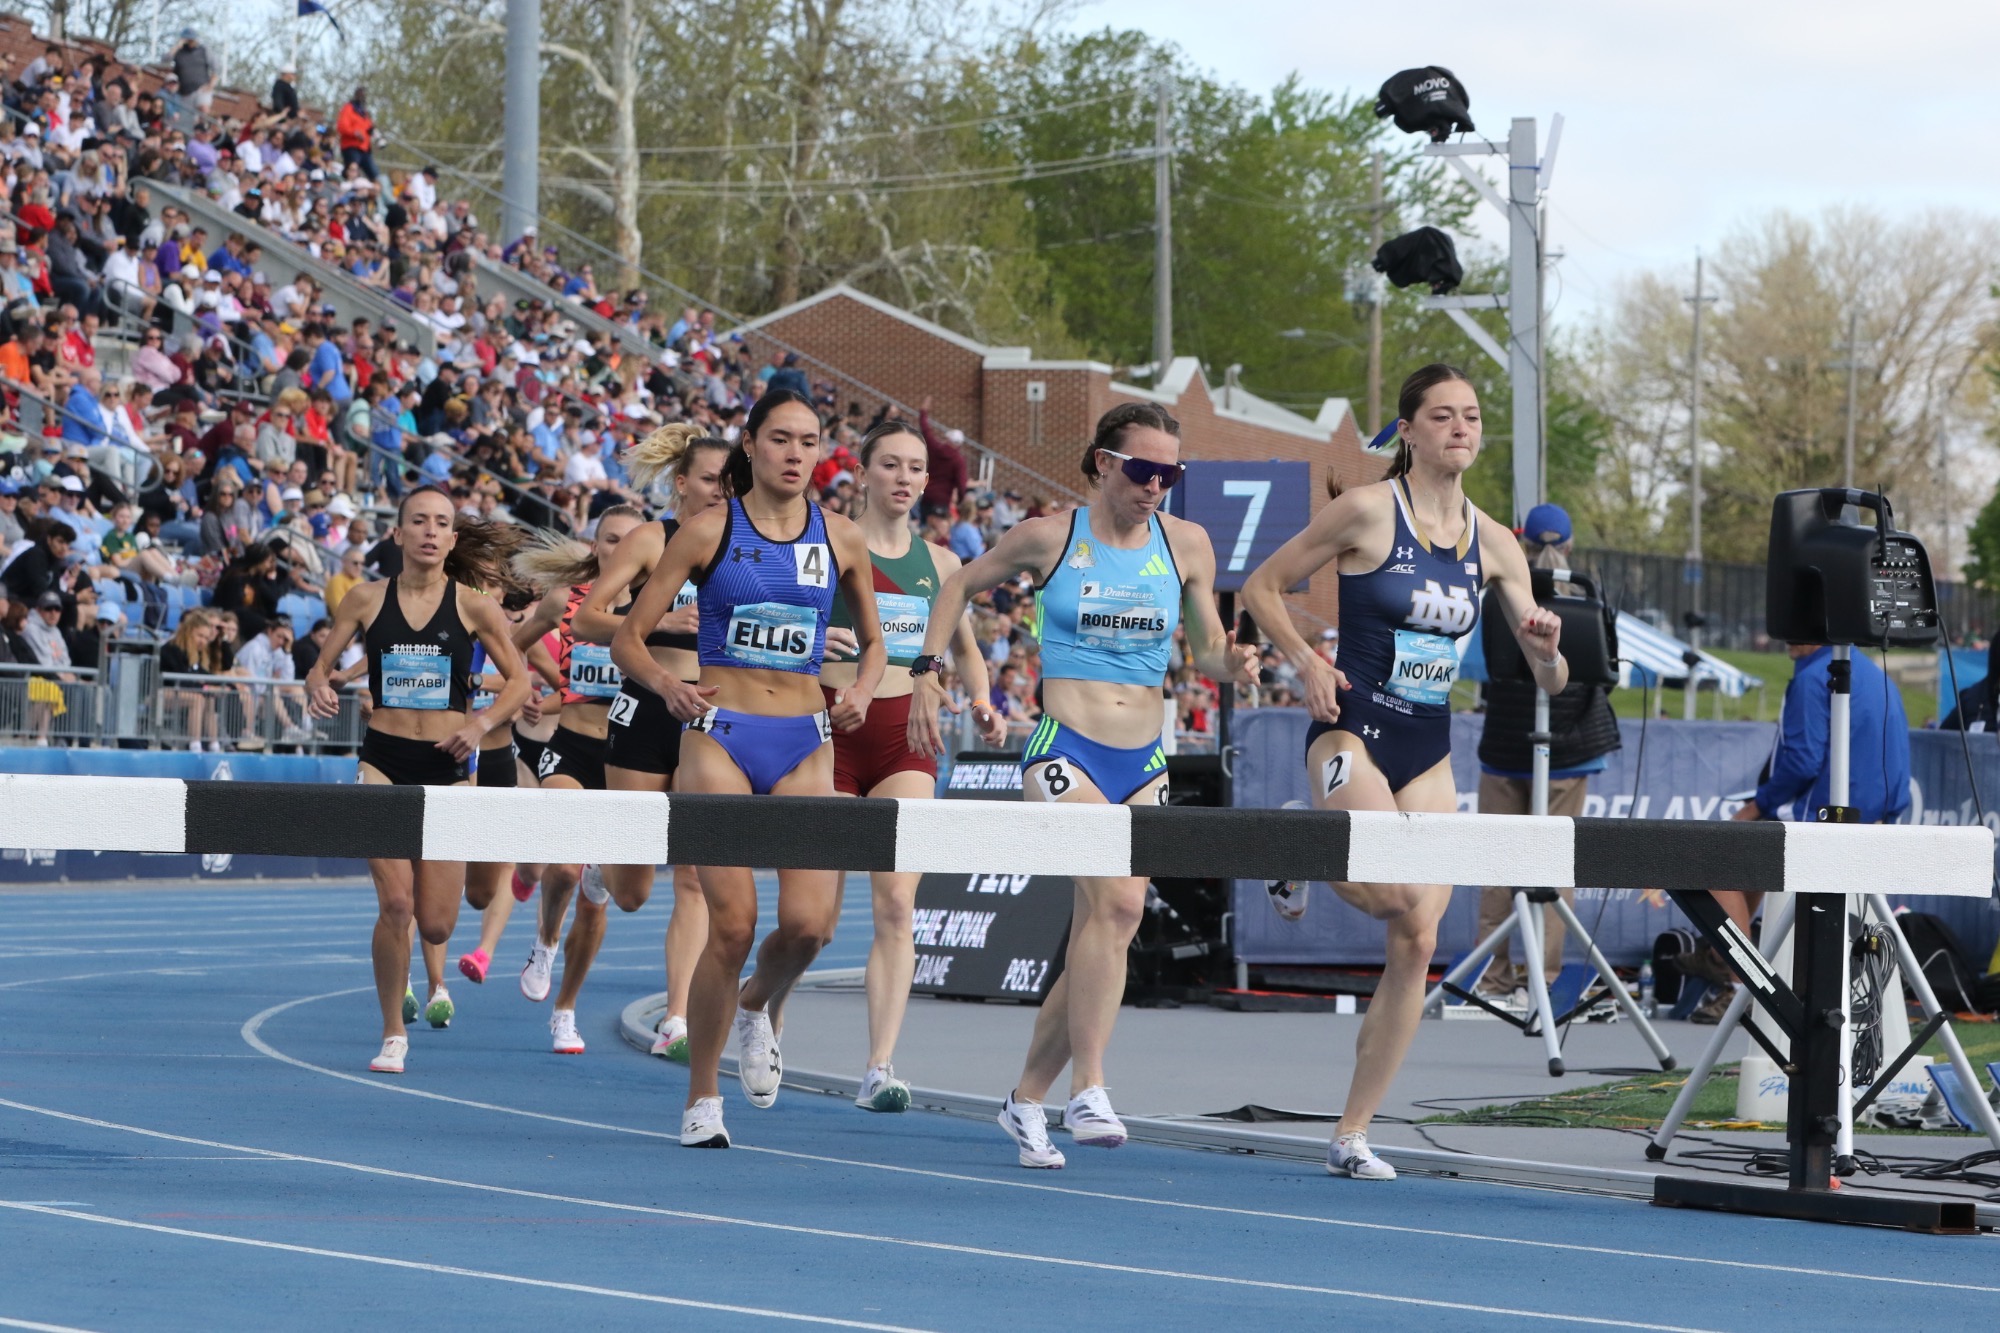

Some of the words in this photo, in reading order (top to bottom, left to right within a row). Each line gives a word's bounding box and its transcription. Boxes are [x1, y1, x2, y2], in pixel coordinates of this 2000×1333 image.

[1414, 77, 1450, 96] MOVO
[1223, 480, 1271, 571] 7
[803, 546, 824, 584] 4
[1388, 563, 1416, 573] ACC
[1103, 586, 1131, 598] Drake
[1131, 592, 1154, 600] RELAYS
[880, 621, 925, 633] ONSON
[1081, 613, 1165, 632] RODENFELS
[734, 621, 807, 655] ELLIS
[393, 643, 440, 657] RAILROAD
[386, 676, 446, 688] CURTABBI
[1399, 660, 1455, 683] NOVAK
[609, 696, 630, 722] 12
[541, 751, 554, 773] 9
[1044, 763, 1070, 796] 8
[1328, 755, 1344, 794] 2
[939, 910, 997, 949] NOVAK
